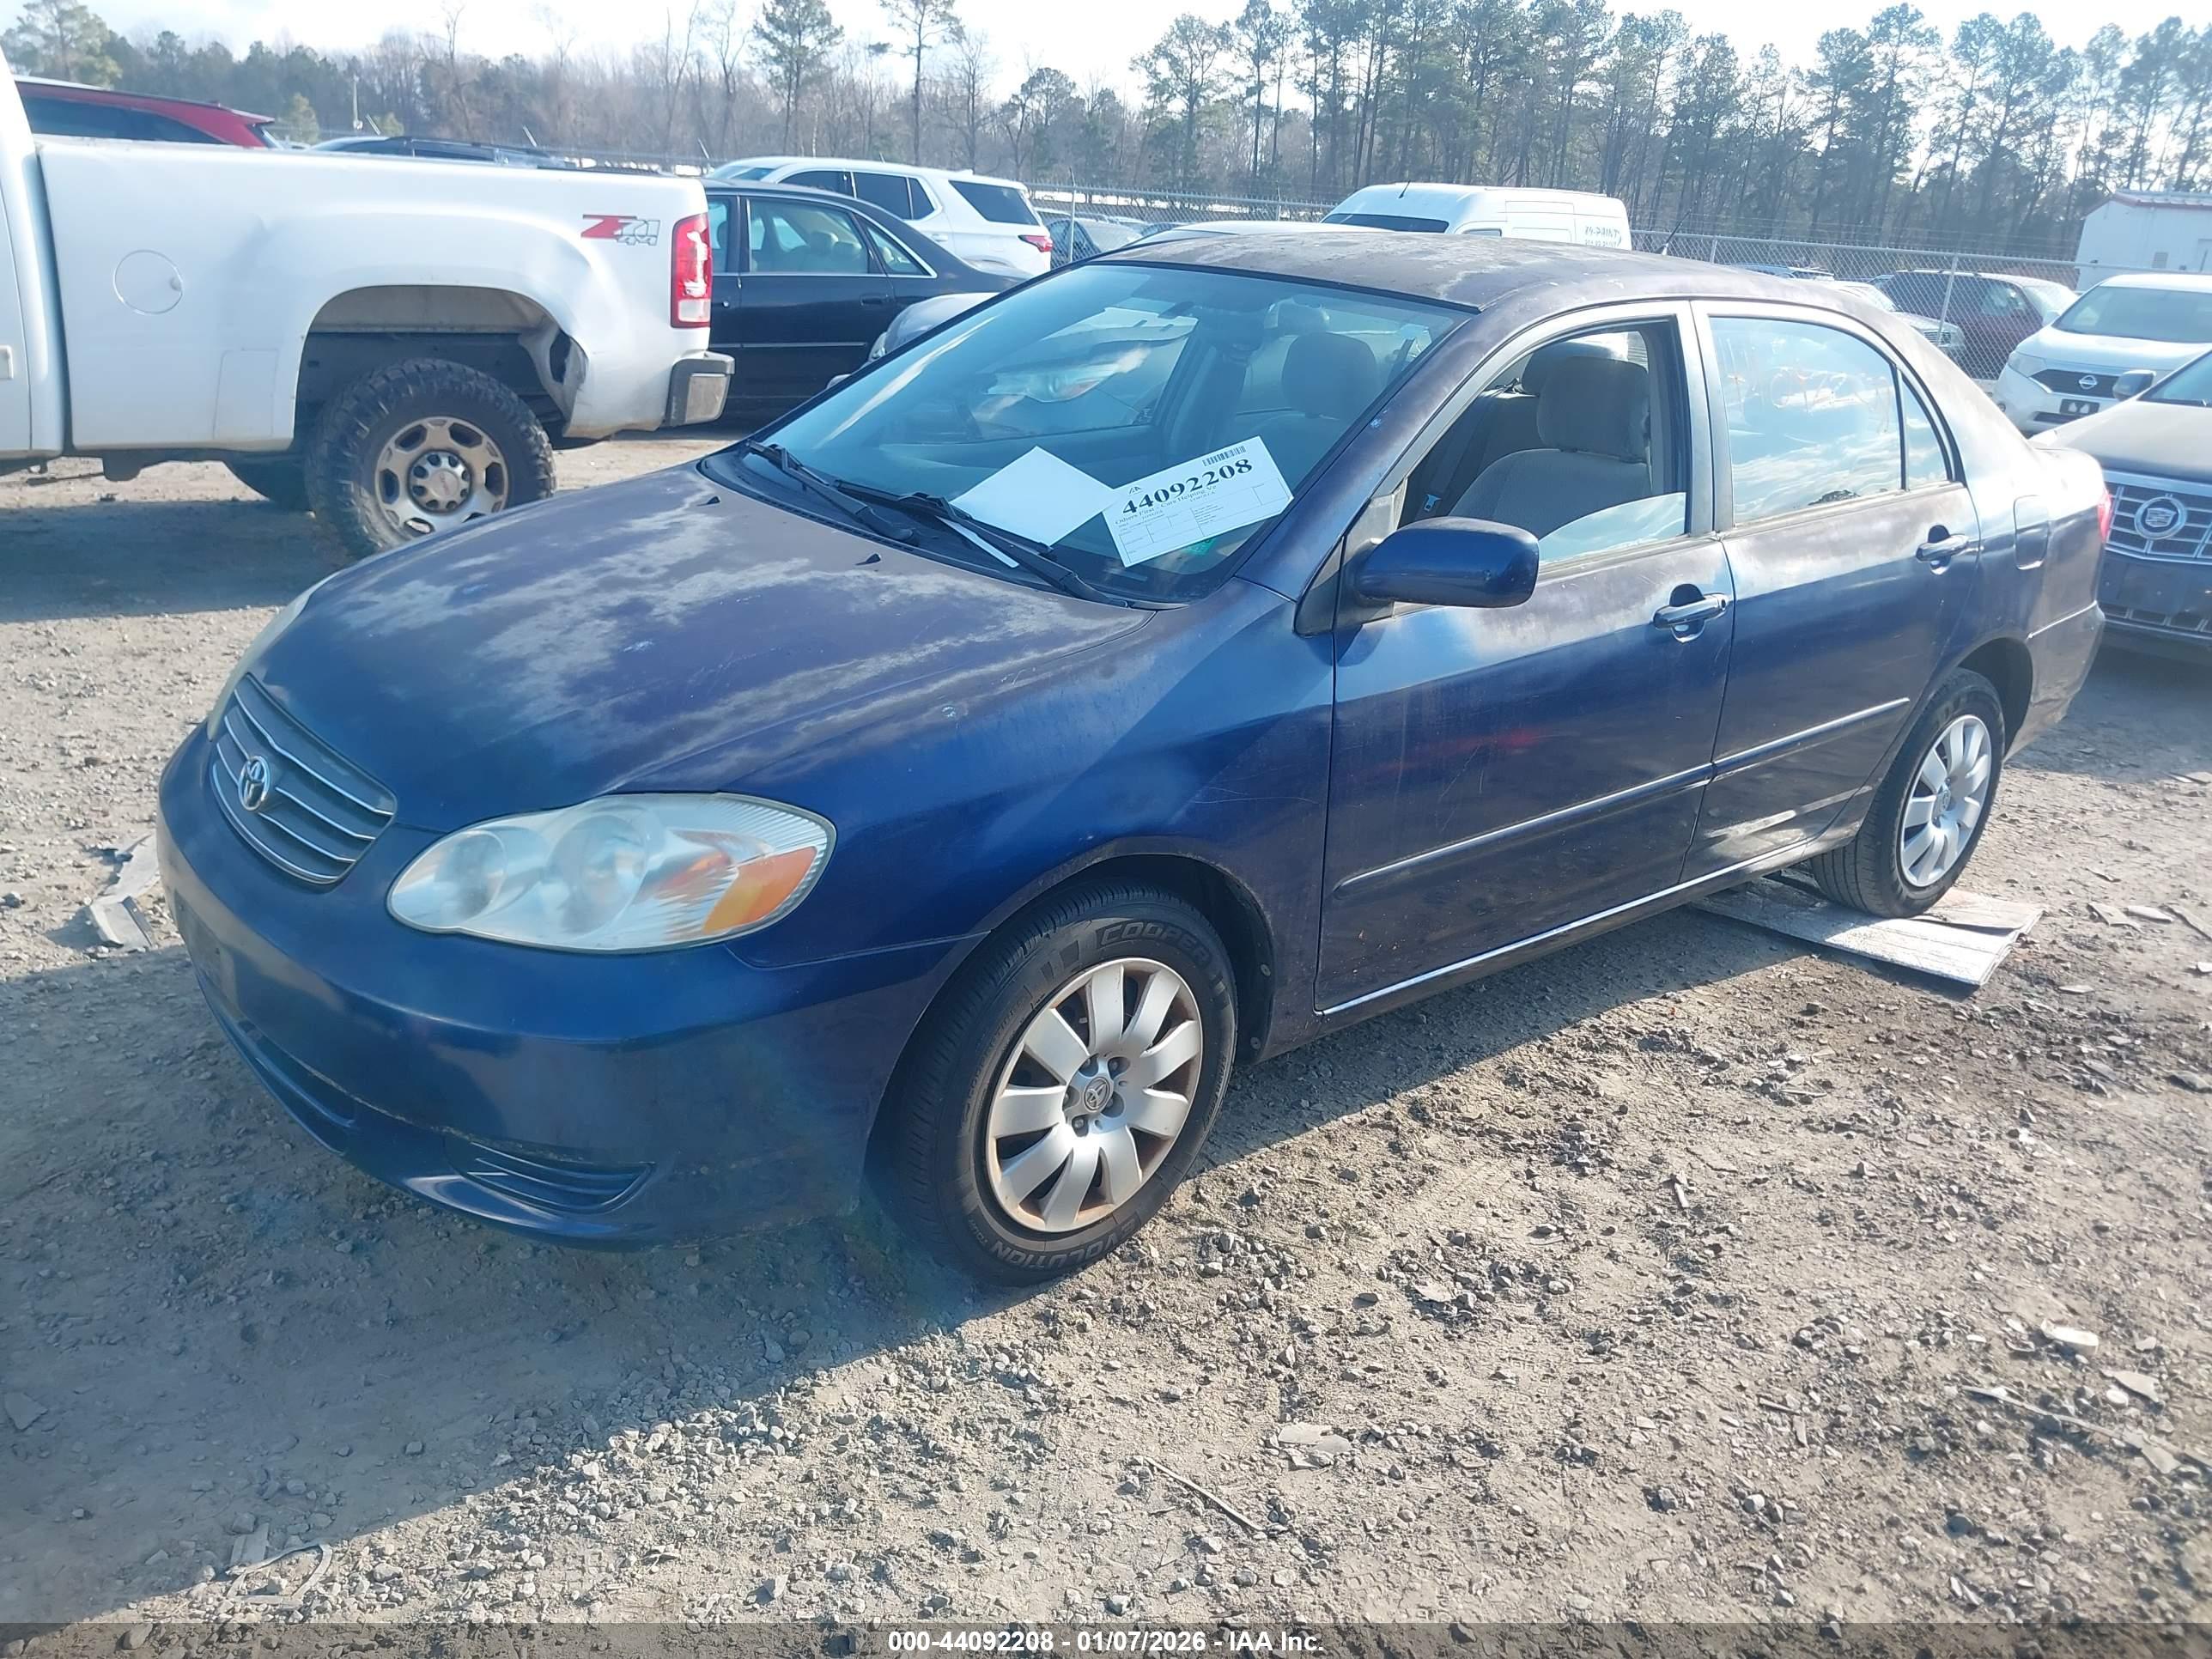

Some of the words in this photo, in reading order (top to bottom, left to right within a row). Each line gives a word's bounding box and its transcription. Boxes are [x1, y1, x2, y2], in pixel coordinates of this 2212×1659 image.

[580, 214, 660, 239] Z71
[1115, 514, 1138, 525] Others
[1139, 507, 1155, 516] First
[1177, 489, 1206, 503] Helping
[1122, 459, 1252, 514] 44092208
[1100, 921, 1211, 965] COOPER
[989, 1218, 1137, 1269] EVOLUTION
